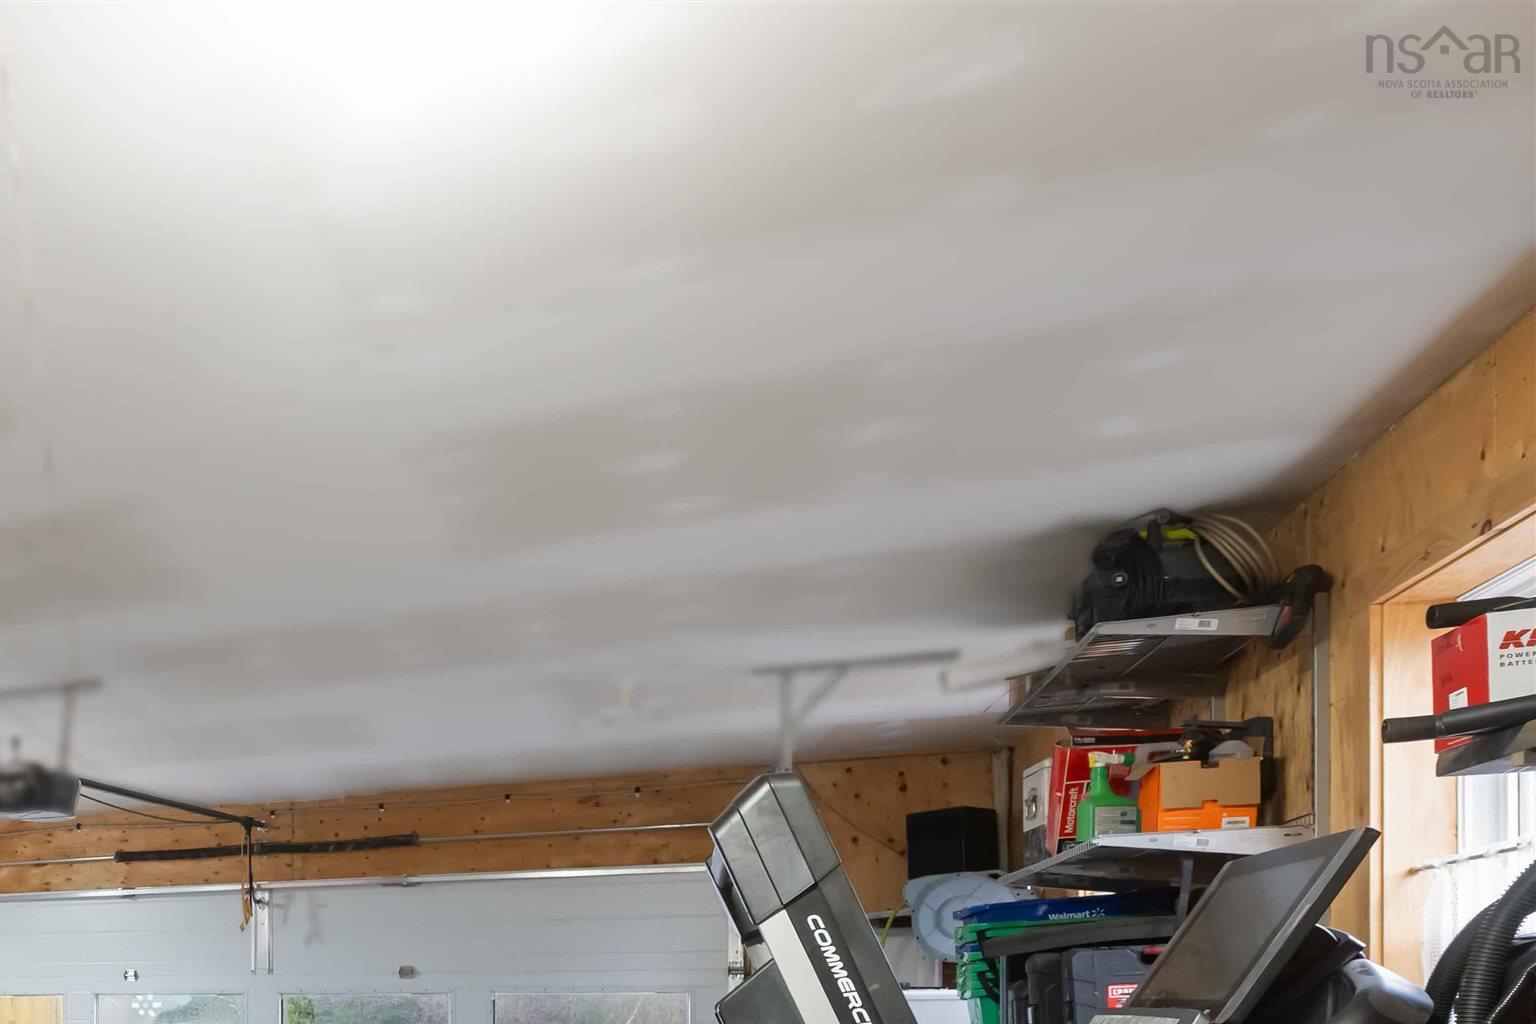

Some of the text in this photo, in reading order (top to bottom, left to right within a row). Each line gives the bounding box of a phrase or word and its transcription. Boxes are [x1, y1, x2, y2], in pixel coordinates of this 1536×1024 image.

[1500, 659, 1536, 668] BATTE
[1064, 786, 1079, 834] Motorcraft
[1048, 910, 1091, 920] Walmart
